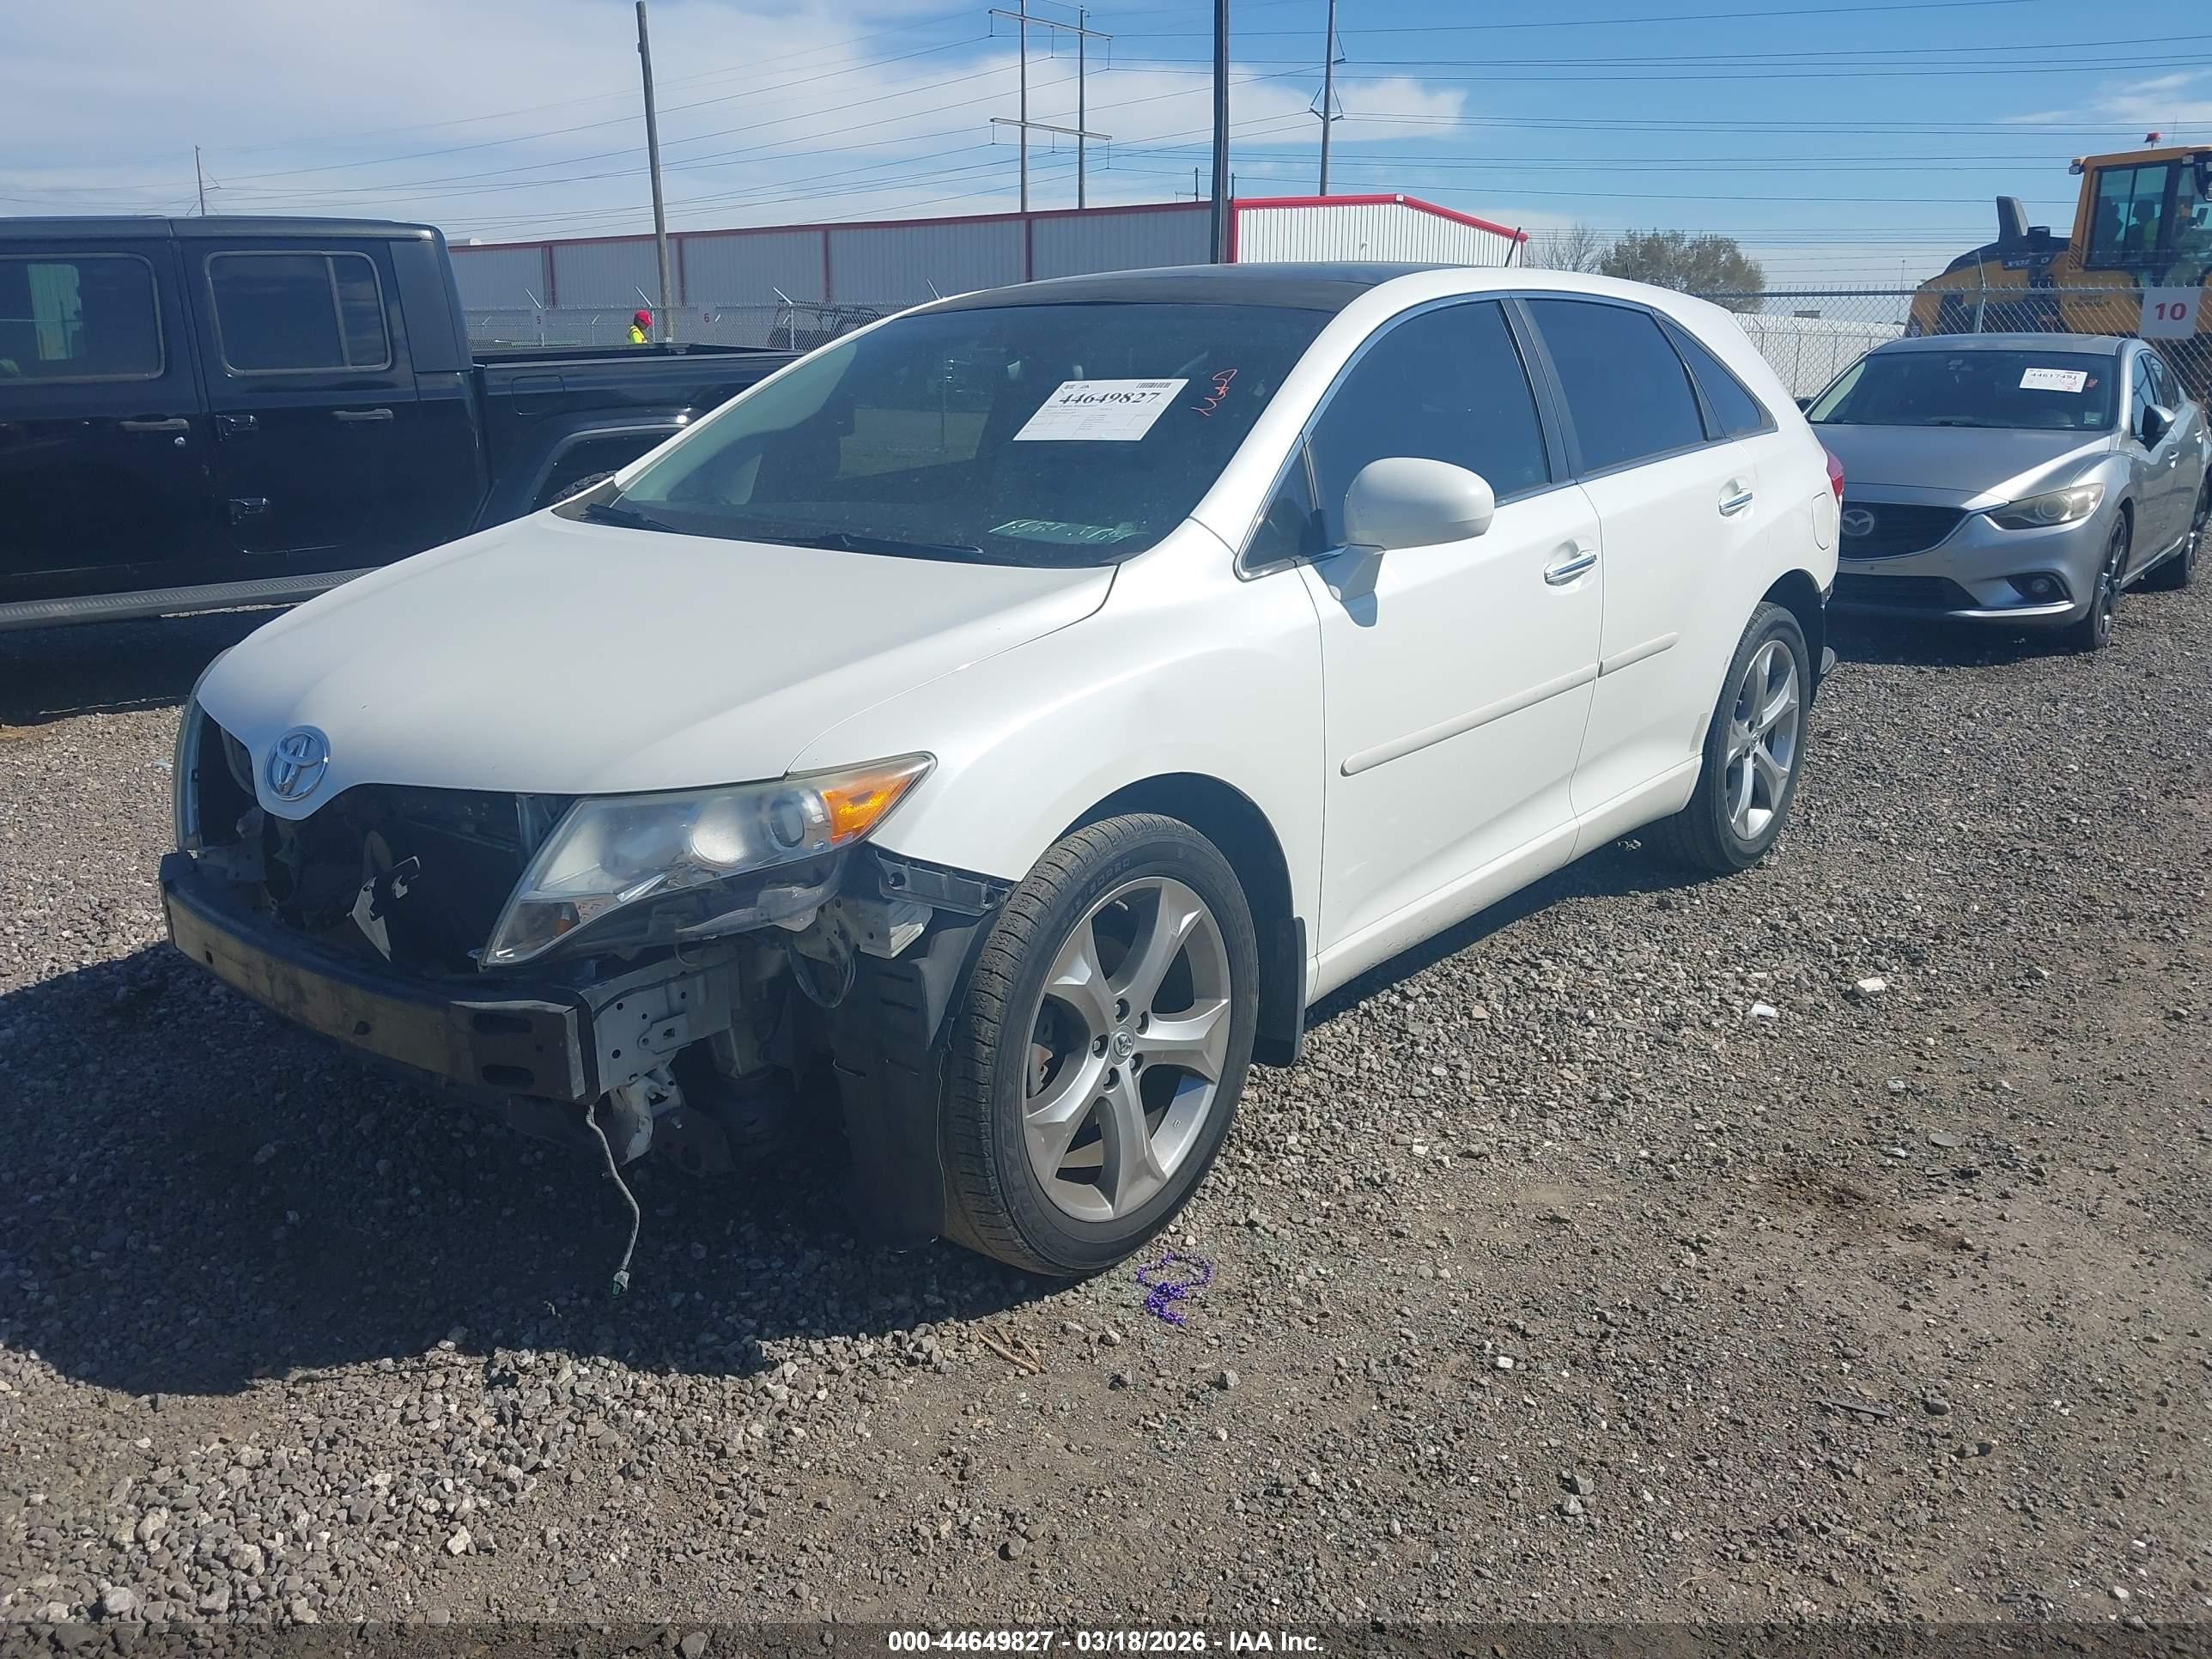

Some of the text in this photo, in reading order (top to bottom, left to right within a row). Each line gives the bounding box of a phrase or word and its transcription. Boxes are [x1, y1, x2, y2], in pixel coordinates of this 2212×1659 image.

[2154, 302, 2187, 321] 10
[536, 315, 542, 325] 5
[703, 313, 711, 323] 6
[1058, 392, 1163, 405] 44649827
